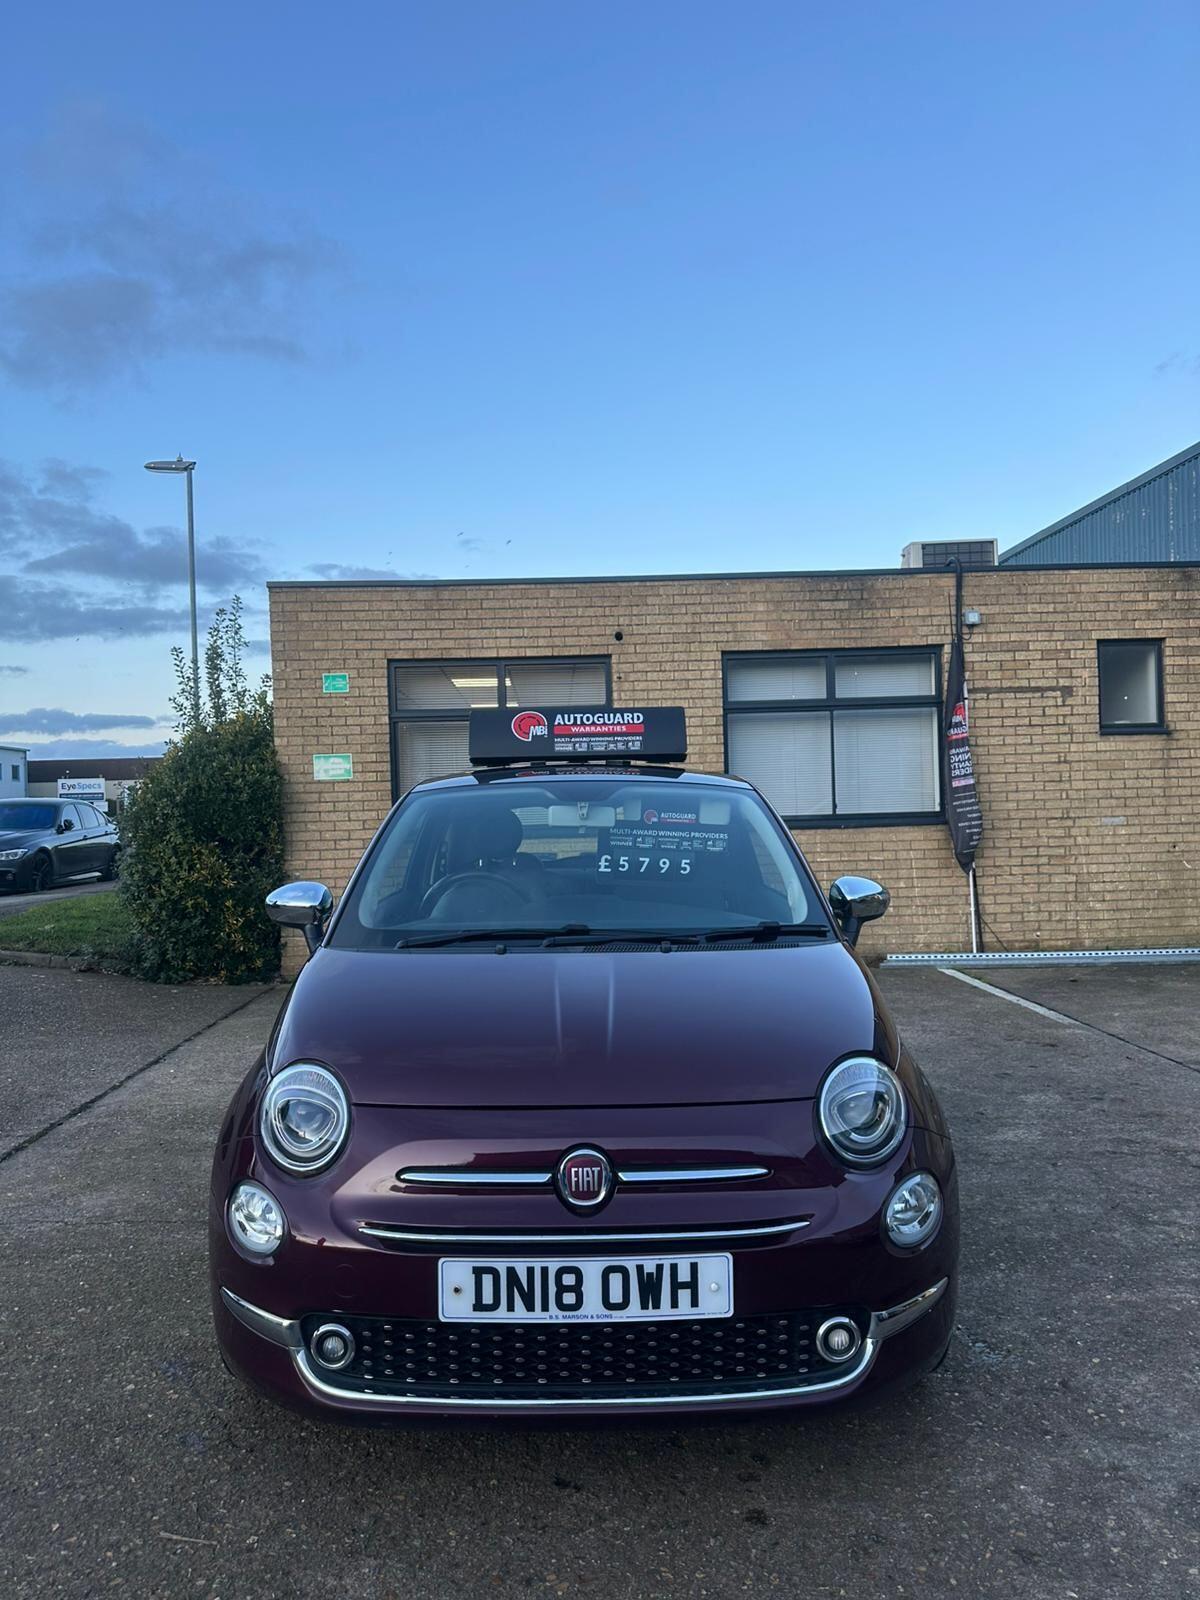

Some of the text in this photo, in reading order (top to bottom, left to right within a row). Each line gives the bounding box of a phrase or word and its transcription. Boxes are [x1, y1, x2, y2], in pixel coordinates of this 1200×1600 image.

[554, 713, 644, 725] AUTOGUARD
[570, 725, 627, 733] WARRANTIES
[61, 782, 102, 790] EyeSpecs
[660, 812, 697, 820] AUTOGUARD
[609, 828, 729, 840] MULTI-AWARD WINNING PROVIDERS
[571, 1167, 600, 1192] FIAT
[471, 1261, 699, 1313] DN18 OWH
